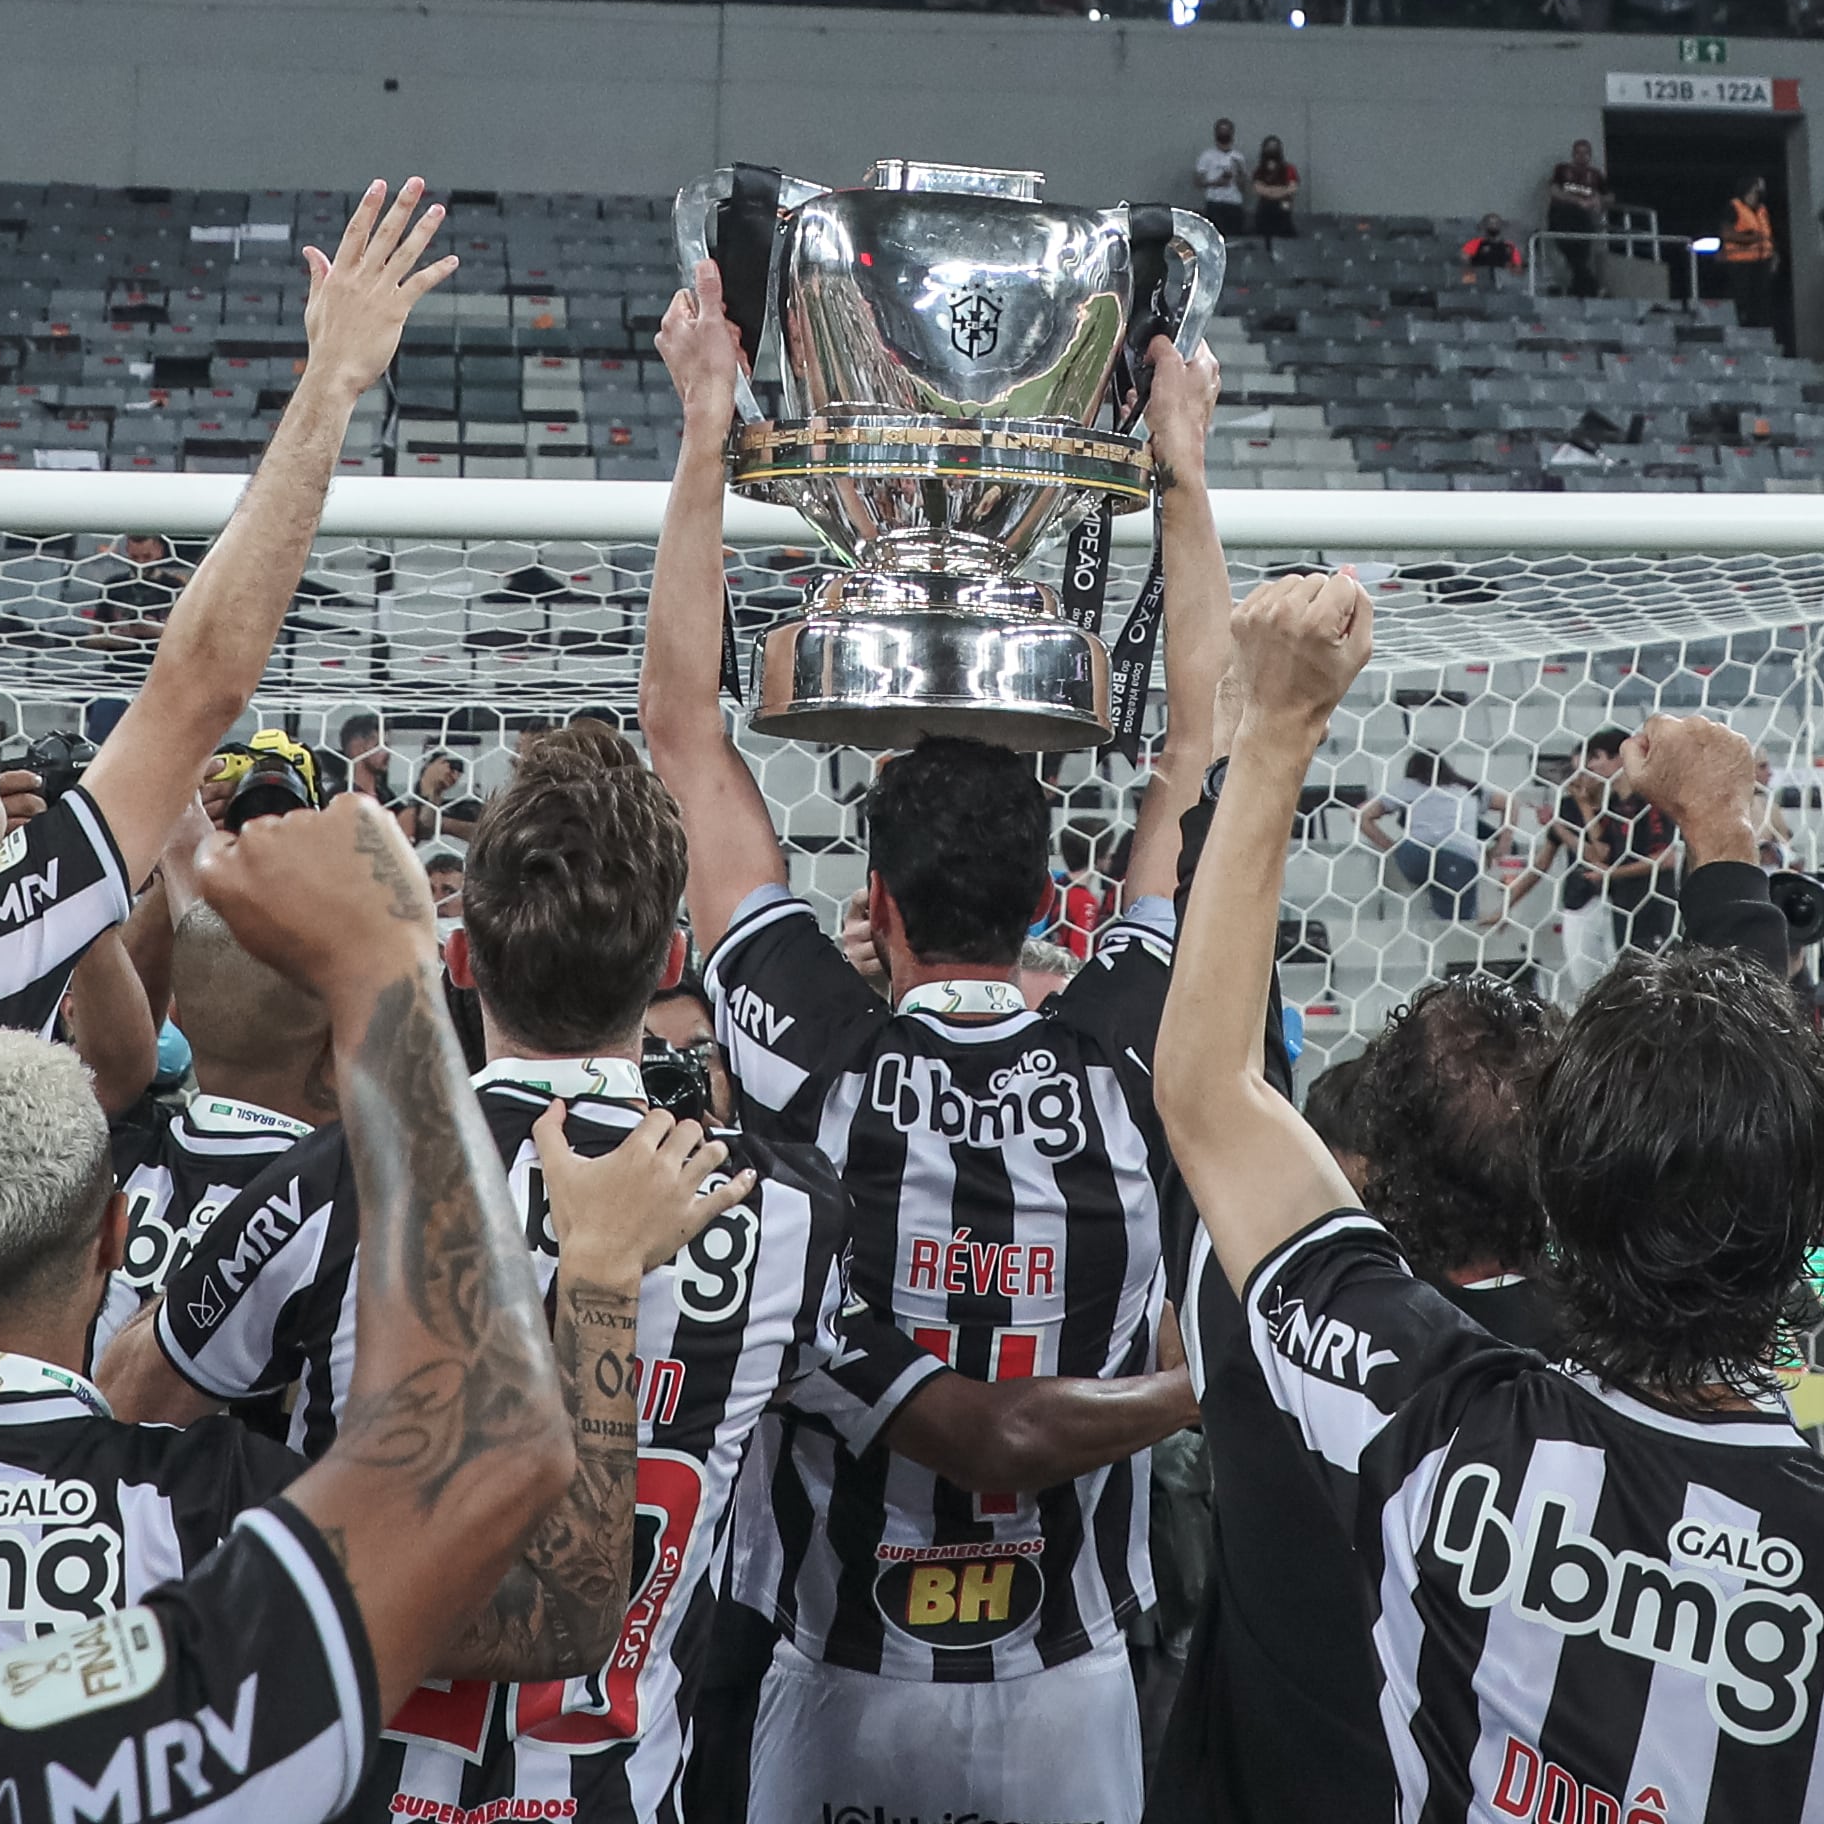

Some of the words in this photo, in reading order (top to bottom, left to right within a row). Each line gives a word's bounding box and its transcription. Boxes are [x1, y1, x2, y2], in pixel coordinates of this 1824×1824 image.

[1643, 81, 1694, 101] 123B
[1716, 82, 1768, 102] 122A
[236, 1107, 277, 1127] BRASIL
[216, 1176, 303, 1294] MRV
[908, 1227, 1056, 1298] RÉVER
[877, 1537, 1045, 1563] SUPERMERCADOS
[1676, 1524, 1796, 1577] GALO
[903, 1560, 1016, 1626] BH
[1522, 1500, 1813, 1736] bmg
[44, 1671, 259, 1824] MRV
